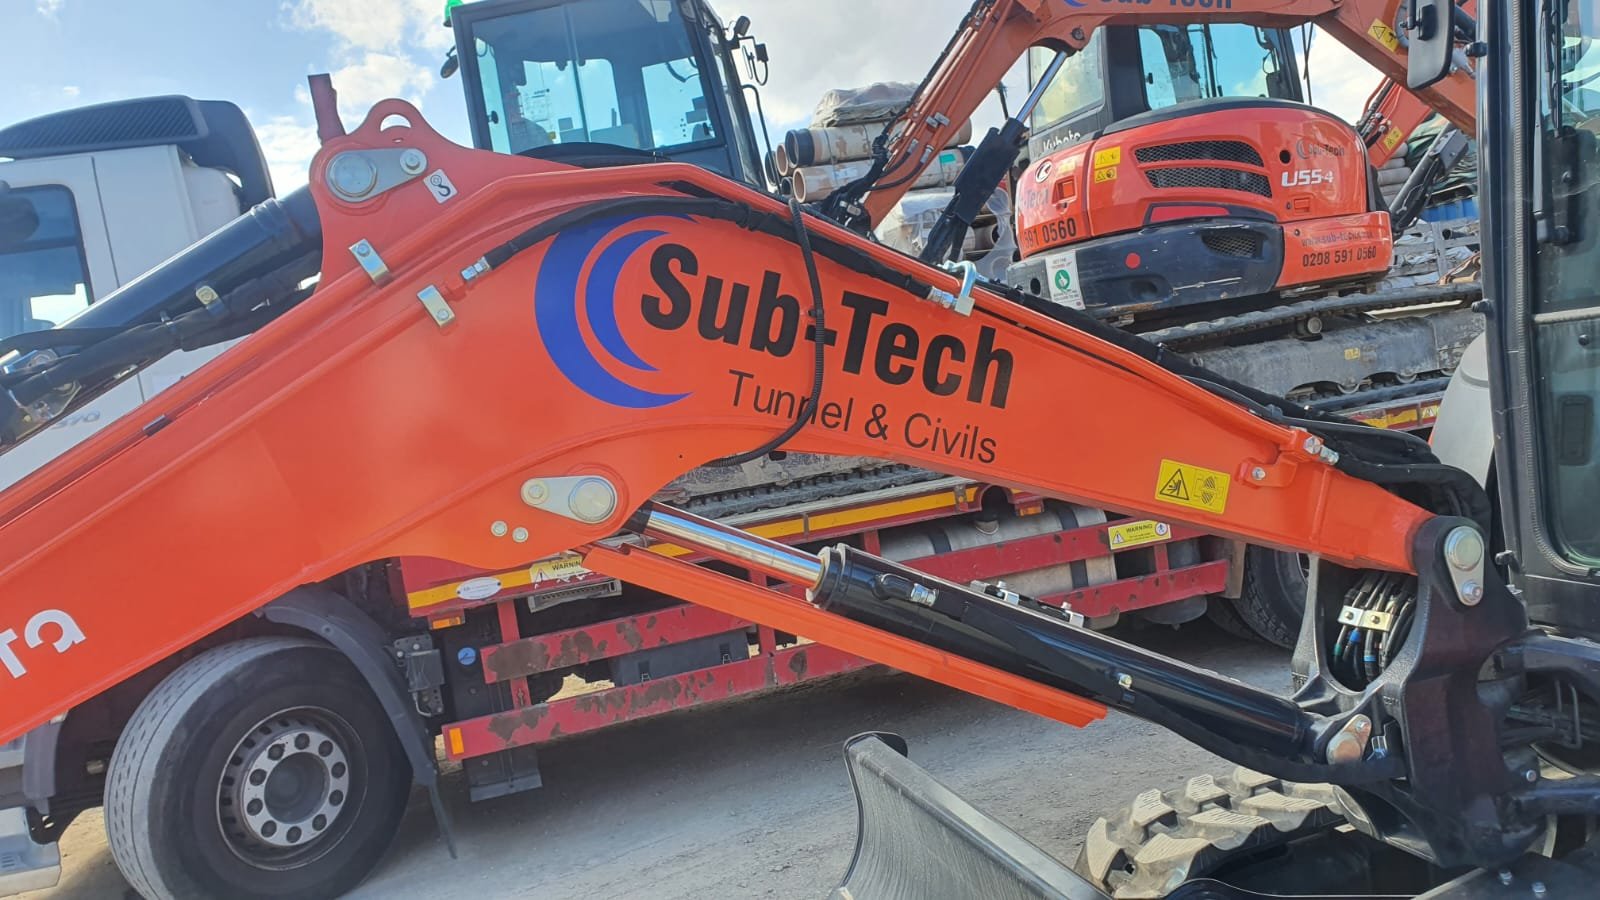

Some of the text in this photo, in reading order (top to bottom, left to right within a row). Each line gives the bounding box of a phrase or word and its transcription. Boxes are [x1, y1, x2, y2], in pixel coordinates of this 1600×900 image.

[1042, 217, 1077, 243] 0560
[1302, 246, 1377, 267] 0208 591 0560
[640, 243, 1014, 409] Sub-Tech
[728, 369, 997, 464] Tunnel & Civils
[552, 559, 581, 571] WARNIN
